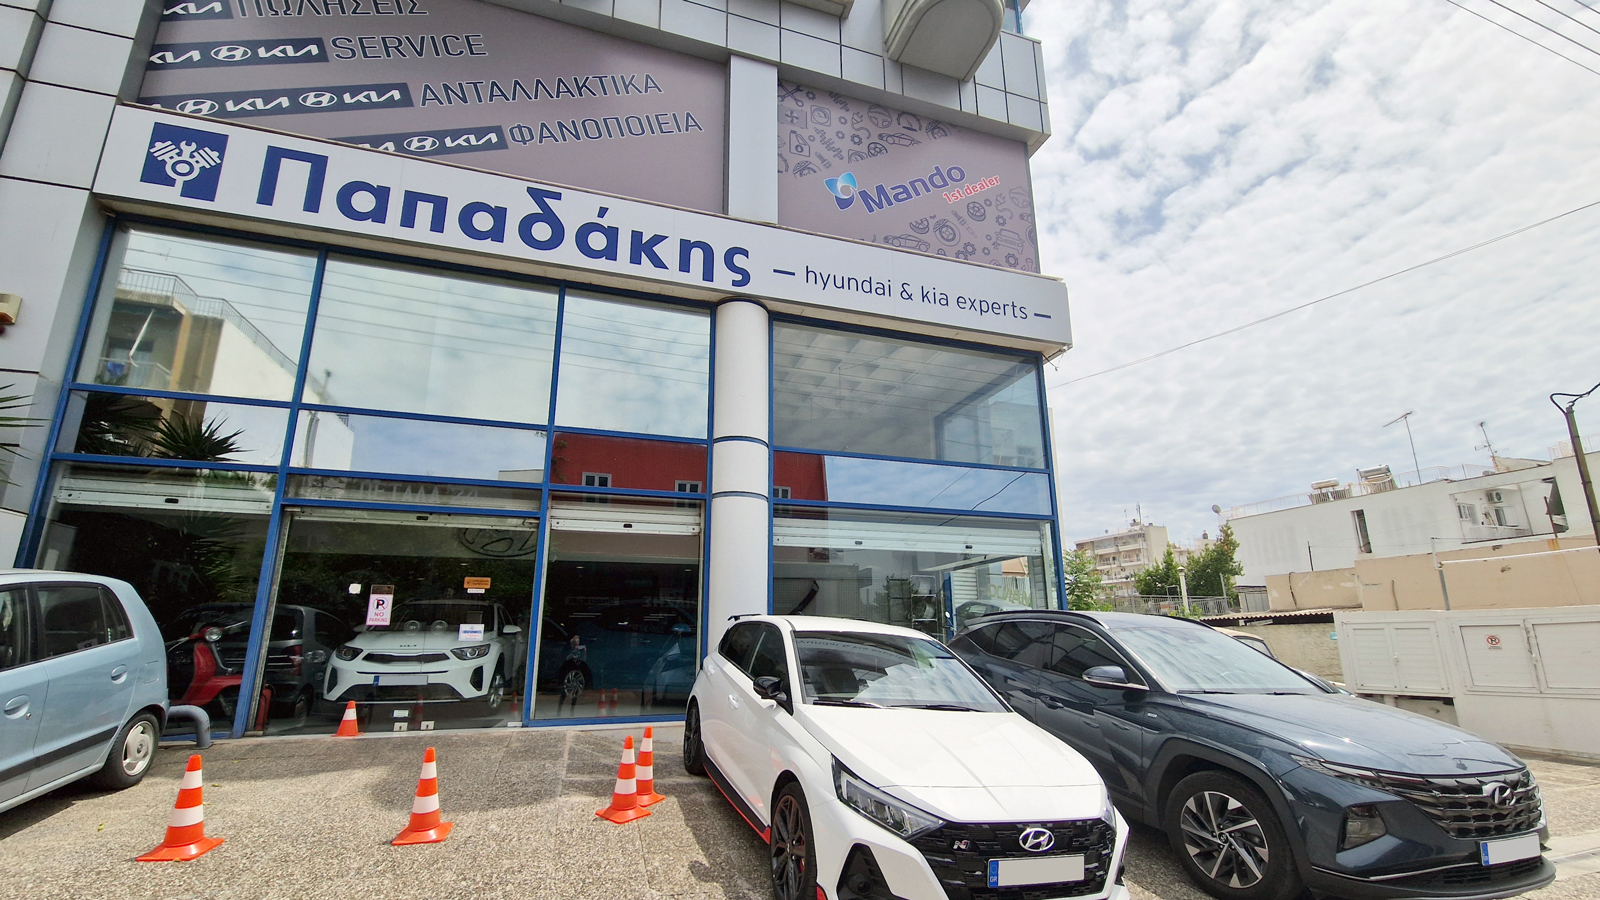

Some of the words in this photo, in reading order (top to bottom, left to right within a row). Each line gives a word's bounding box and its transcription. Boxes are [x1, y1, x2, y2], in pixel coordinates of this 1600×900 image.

[257, 45, 318, 58] KIA
[331, 34, 488, 60] SERVICE
[226, 97, 289, 112] KIA
[343, 90, 402, 104] KIA
[421, 74, 663, 107] ΑΝΤΑΛΛΑΚΤΙΚΑ
[444, 132, 498, 147] KIA
[508, 111, 704, 145] ΦΑΝΟΠΟΙΕΙΑ
[857, 165, 966, 214] Mando
[943, 189, 963, 204] 1st
[964, 174, 1001, 197] dealer
[256, 145, 751, 287] Παπαδάκης
[805, 265, 893, 298] hyundai
[899, 282, 913, 301] &
[920, 285, 949, 307] kia
[956, 295, 1029, 320] experts
